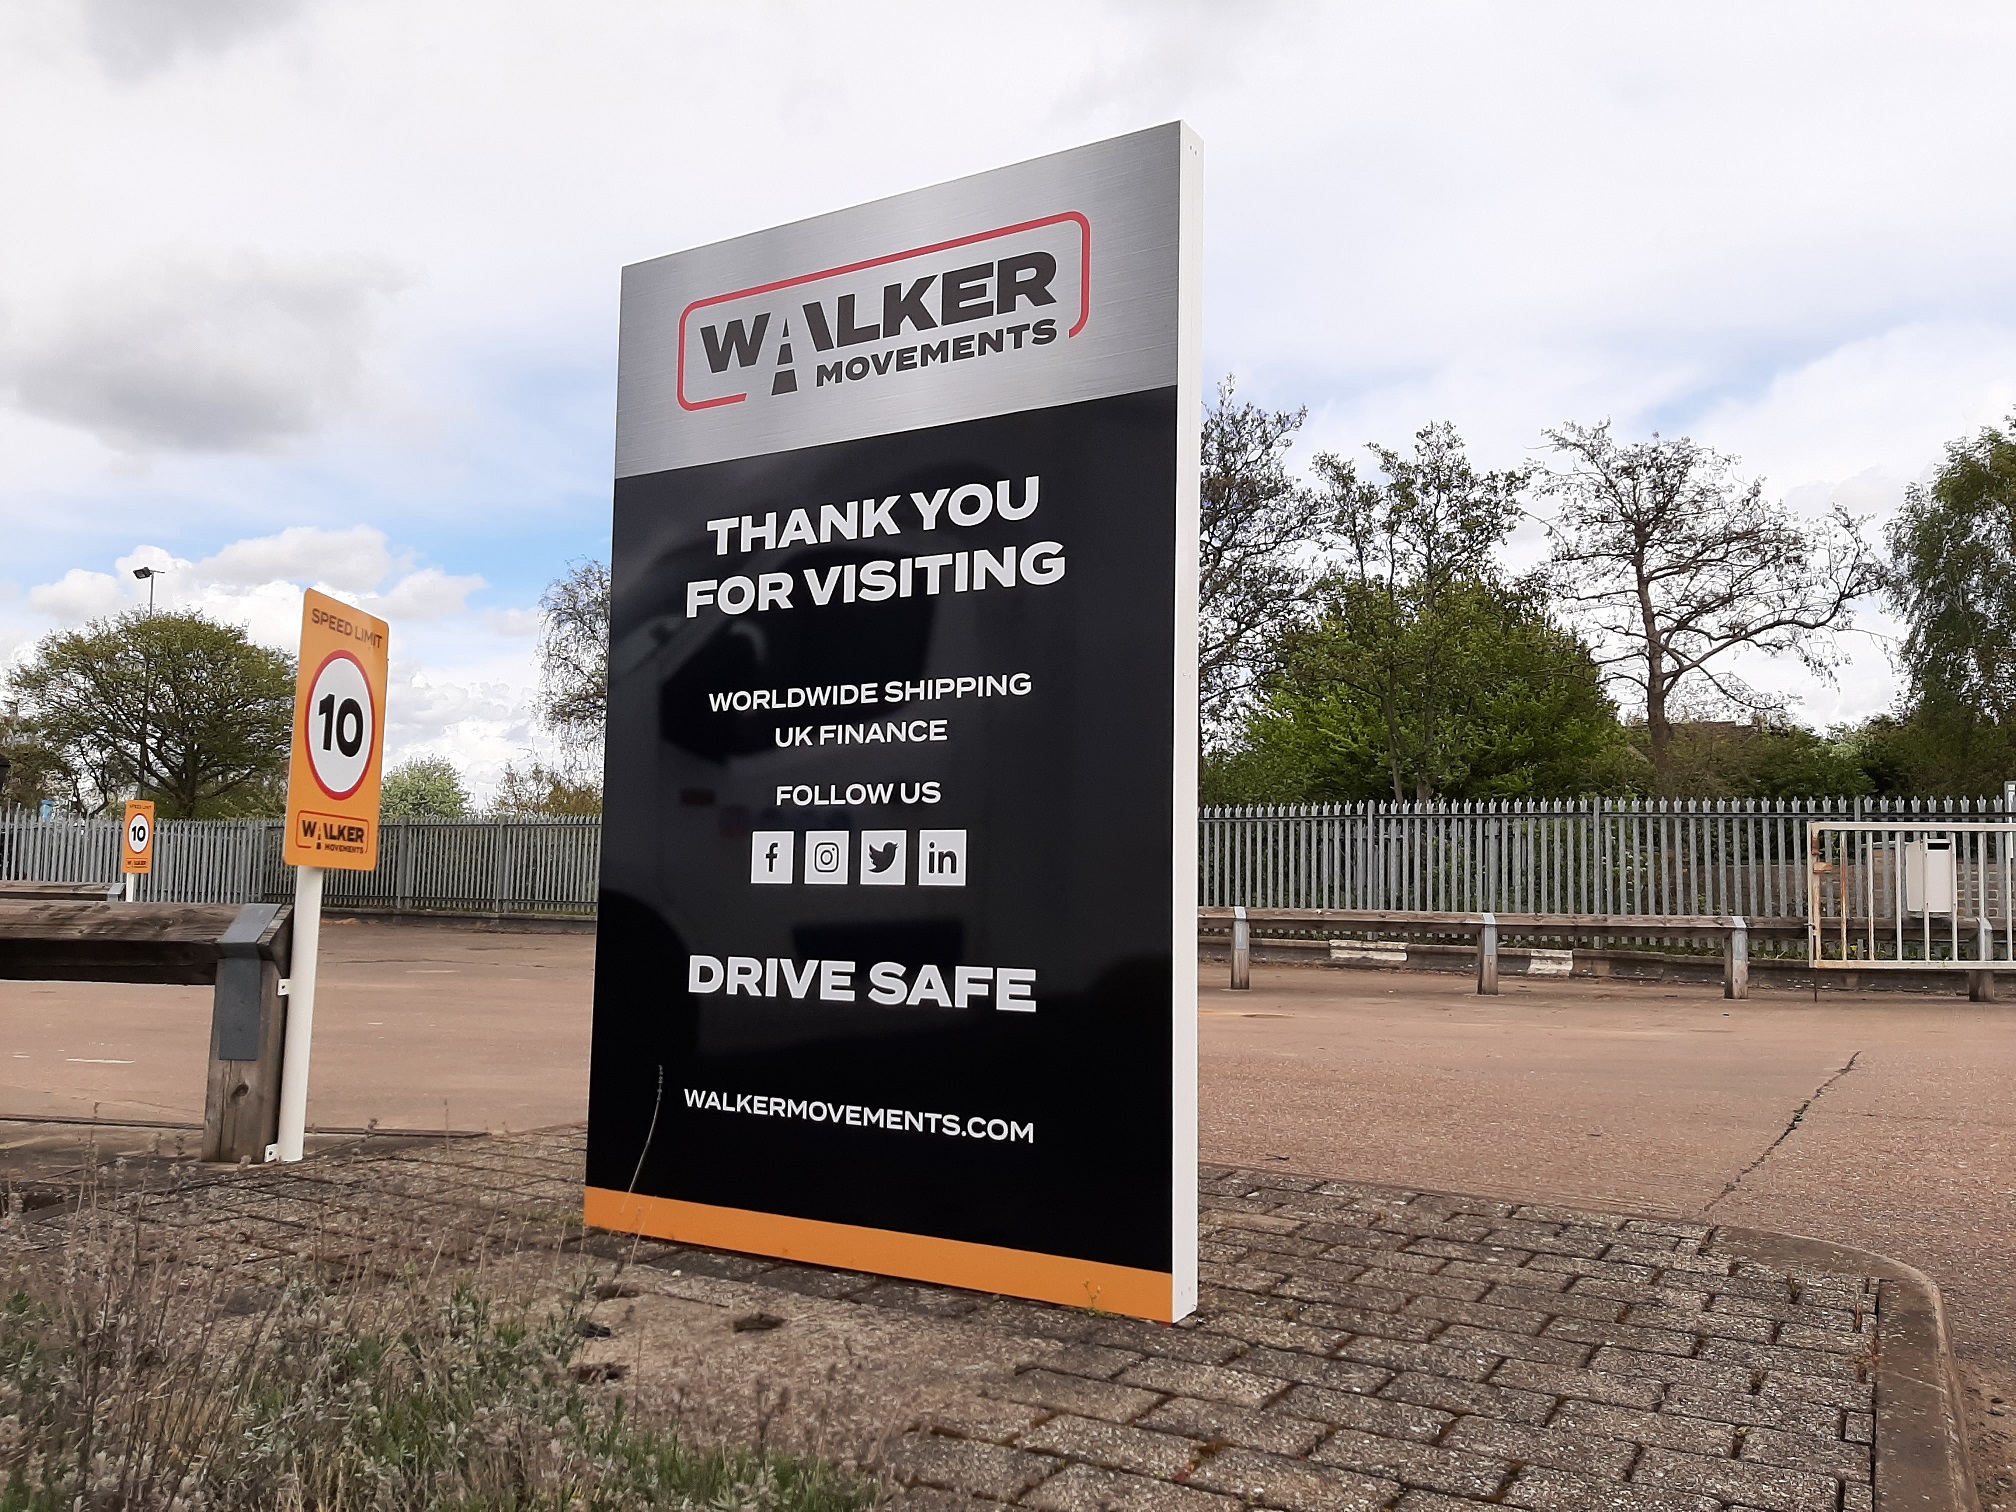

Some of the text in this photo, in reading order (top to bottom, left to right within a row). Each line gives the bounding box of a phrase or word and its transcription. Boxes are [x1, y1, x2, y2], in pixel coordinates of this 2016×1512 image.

[700, 251, 1057, 396] WALKER
[816, 318, 1057, 387] MOVEMENTS
[706, 475, 1040, 556] THANK YOU
[686, 541, 1066, 618] FOR VISITING
[311, 608, 383, 649] SPEED LIMIT
[708, 672, 1032, 712] WORLDWIDE SHIPPING
[318, 693, 364, 757] 10
[775, 719, 948, 748] UK FINANCE
[776, 781, 942, 806] FOLLOW US
[131, 825, 146, 842] 10
[302, 820, 365, 850] WALKER
[688, 955, 1037, 1012] DRIVE SAFE
[684, 1088, 1034, 1144] WALKERMOVEMENTS.COM
